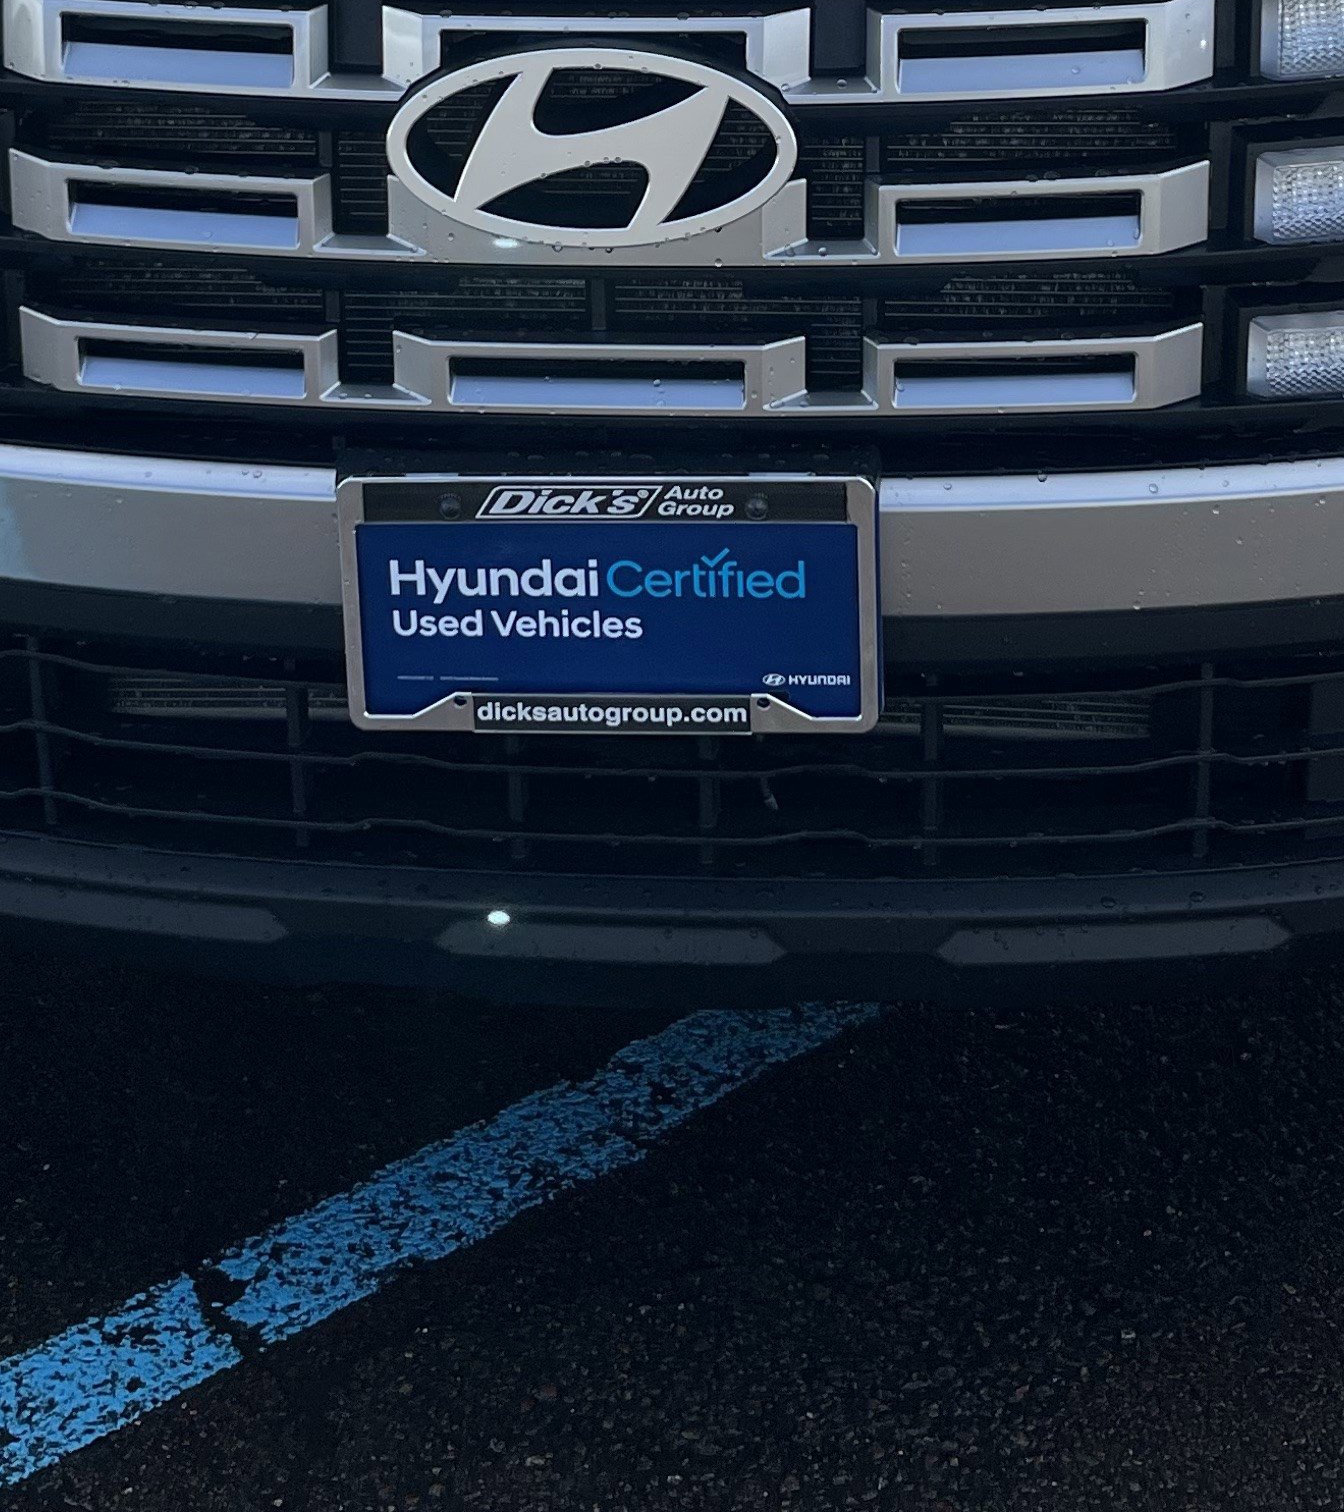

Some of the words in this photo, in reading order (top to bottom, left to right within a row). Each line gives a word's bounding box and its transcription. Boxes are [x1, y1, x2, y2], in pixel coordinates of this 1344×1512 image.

[488, 489, 640, 514] Dick's
[664, 486, 724, 500] Auto
[658, 501, 735, 518] Group
[388, 559, 599, 605] Hyundai
[606, 548, 806, 599] Certified
[392, 610, 484, 637] Used
[490, 610, 644, 639] Vehicles
[788, 674, 851, 686] HYUNDAI
[476, 701, 748, 729] dicksautogroup.com
